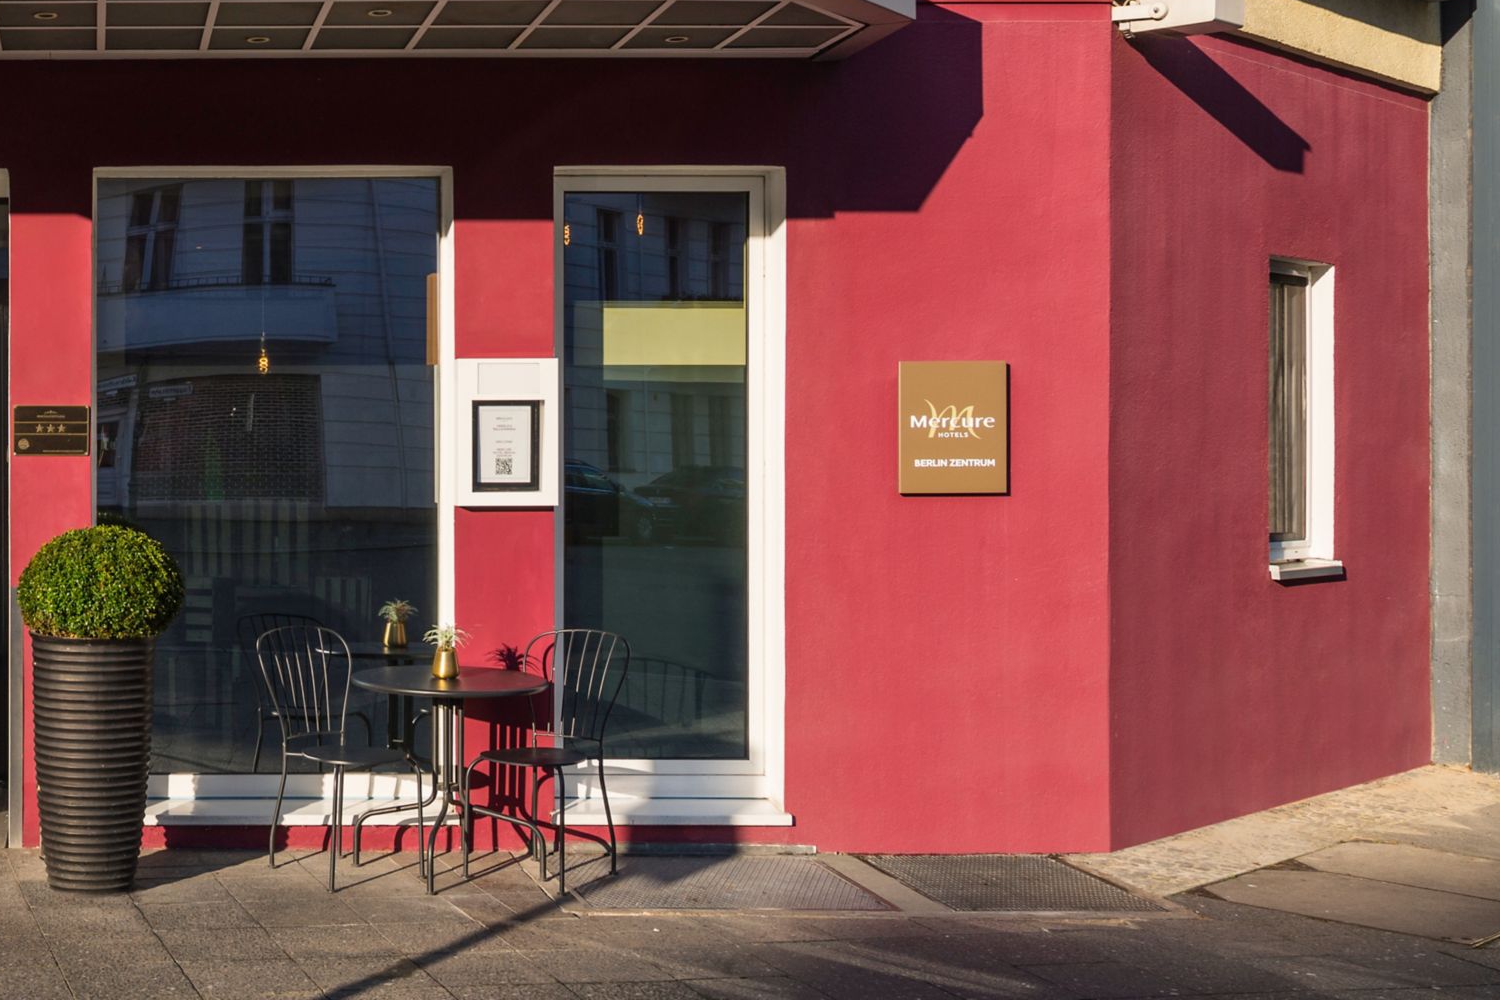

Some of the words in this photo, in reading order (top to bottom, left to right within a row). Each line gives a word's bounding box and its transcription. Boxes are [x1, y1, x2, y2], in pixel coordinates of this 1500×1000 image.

[910, 415, 996, 428] Mercure
[914, 458, 948, 468] BERLIN
[949, 458, 996, 468] ZENTRUM
